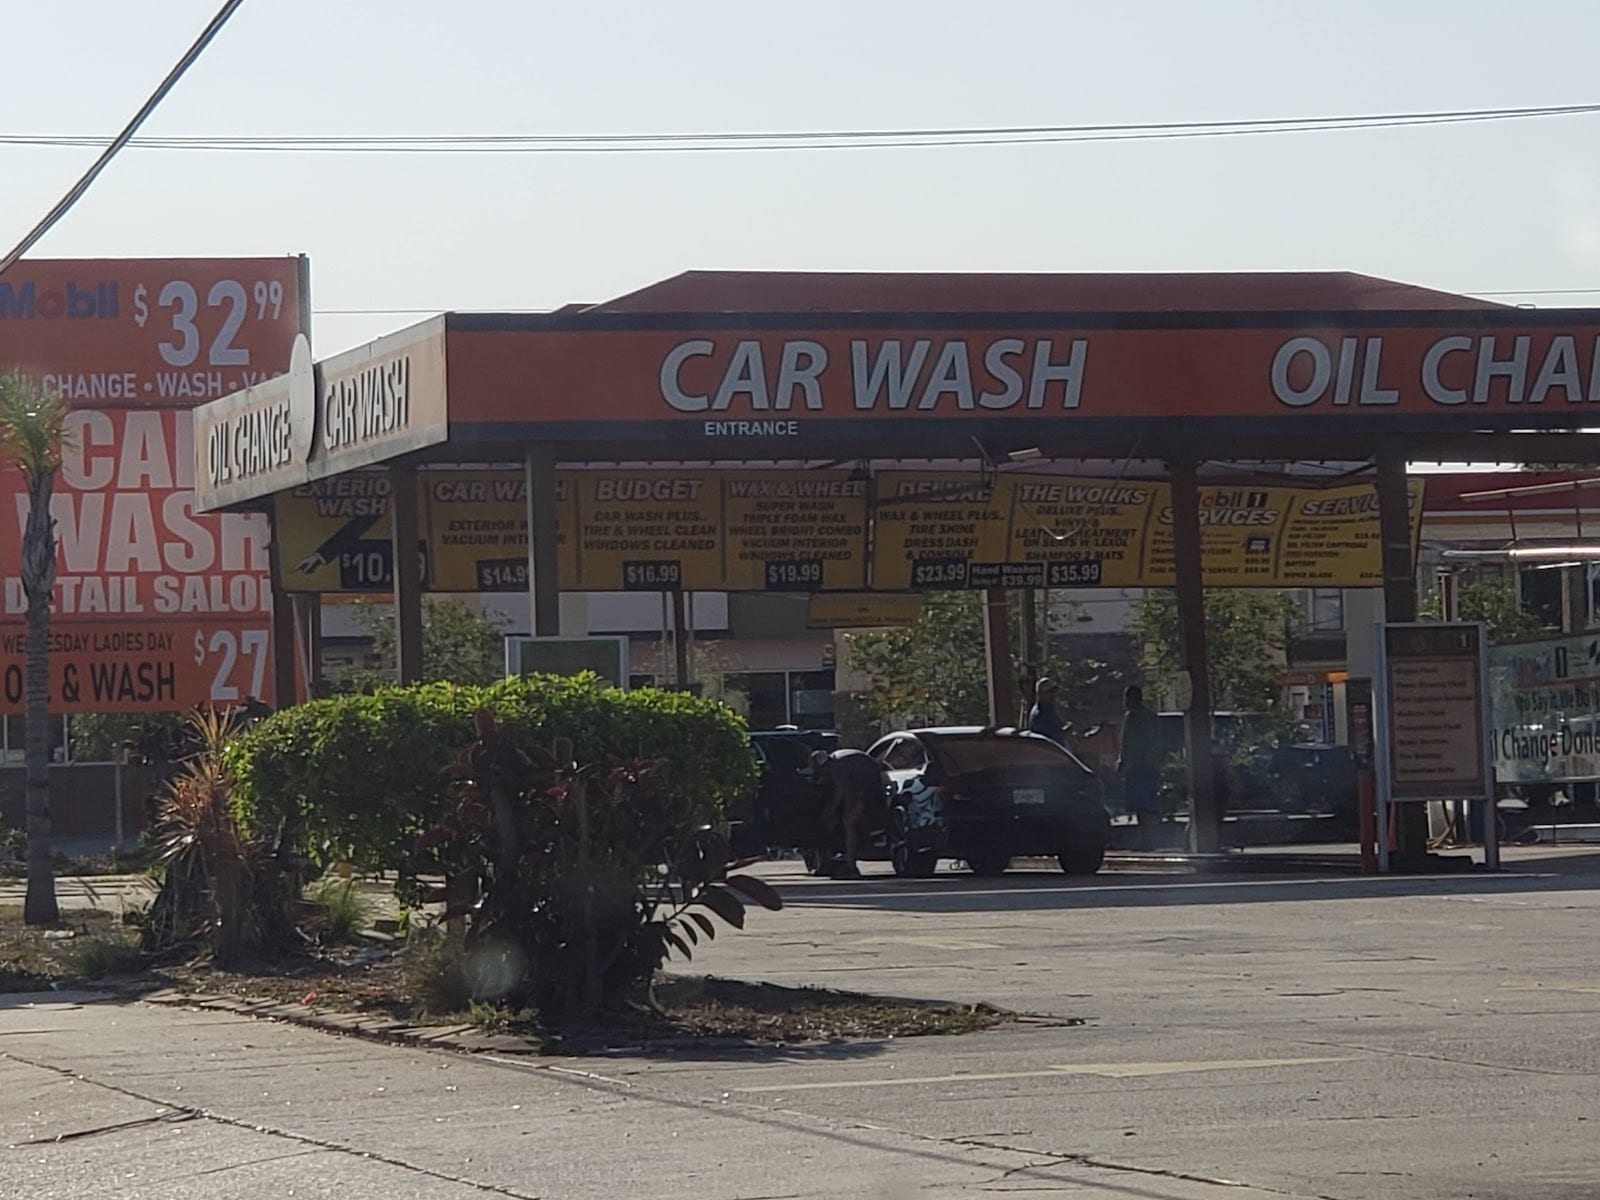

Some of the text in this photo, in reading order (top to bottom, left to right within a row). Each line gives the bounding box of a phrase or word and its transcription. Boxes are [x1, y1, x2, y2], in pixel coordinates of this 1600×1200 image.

[659, 339, 1088, 412] CAR WASH
[1270, 336, 1400, 407] OIL
[42, 373, 137, 398] CHANGE
[156, 373, 223, 397] WASH
[323, 356, 410, 451] CAR WASH
[704, 420, 798, 436] ENTRANCE
[208, 400, 293, 489] OIL CHANGE
[294, 477, 393, 498] EXTERIO
[434, 480, 568, 503] CAR WAH
[595, 479, 704, 501] BUDGET
[729, 481, 863, 497] WAX & WHEEL
[1020, 484, 1148, 505] THE WORKS
[317, 498, 387, 517] WASH
[798, 502, 835, 511] WASH
[1198, 490, 1242, 507] obil
[595, 511, 621, 521] CAR
[625, 511, 663, 521] WASH
[784, 513, 819, 523] FOAM
[879, 510, 906, 520] WAX
[923, 510, 963, 520] WHEEL
[1037, 505, 1082, 515] DELUXE
[1159, 506, 1279, 526] SRVICES
[15, 491, 269, 573] WASH
[448, 520, 515, 531] EXTERIOR
[583, 525, 611, 536] TIRE
[627, 525, 671, 536] WHEEL
[675, 525, 717, 536] CLEAN
[728, 525, 768, 535] WHEEL
[818, 525, 862, 535] COMBO
[909, 523, 977, 533] TIRE SHINE
[442, 533, 499, 545] VACUUM
[584, 540, 716, 550] WINDOWS CLEANED
[793, 538, 849, 548] INTERIOR
[903, 537, 980, 548] DRESS DASH
[1095, 551, 1125, 560] MATS
[482, 565, 528, 586] $14.9
[627, 565, 679, 583] $16.99
[768, 564, 820, 583] $19.99
[916, 563, 965, 583] $23.99
[1050, 564, 1099, 583] $35.99
[4, 575, 144, 614] DTAIL
[3, 632, 173, 653] WEESDAY LADIES DAY
[62, 662, 81, 702] &
[90, 662, 175, 702] WASH
[1502, 726, 1559, 766] Change
